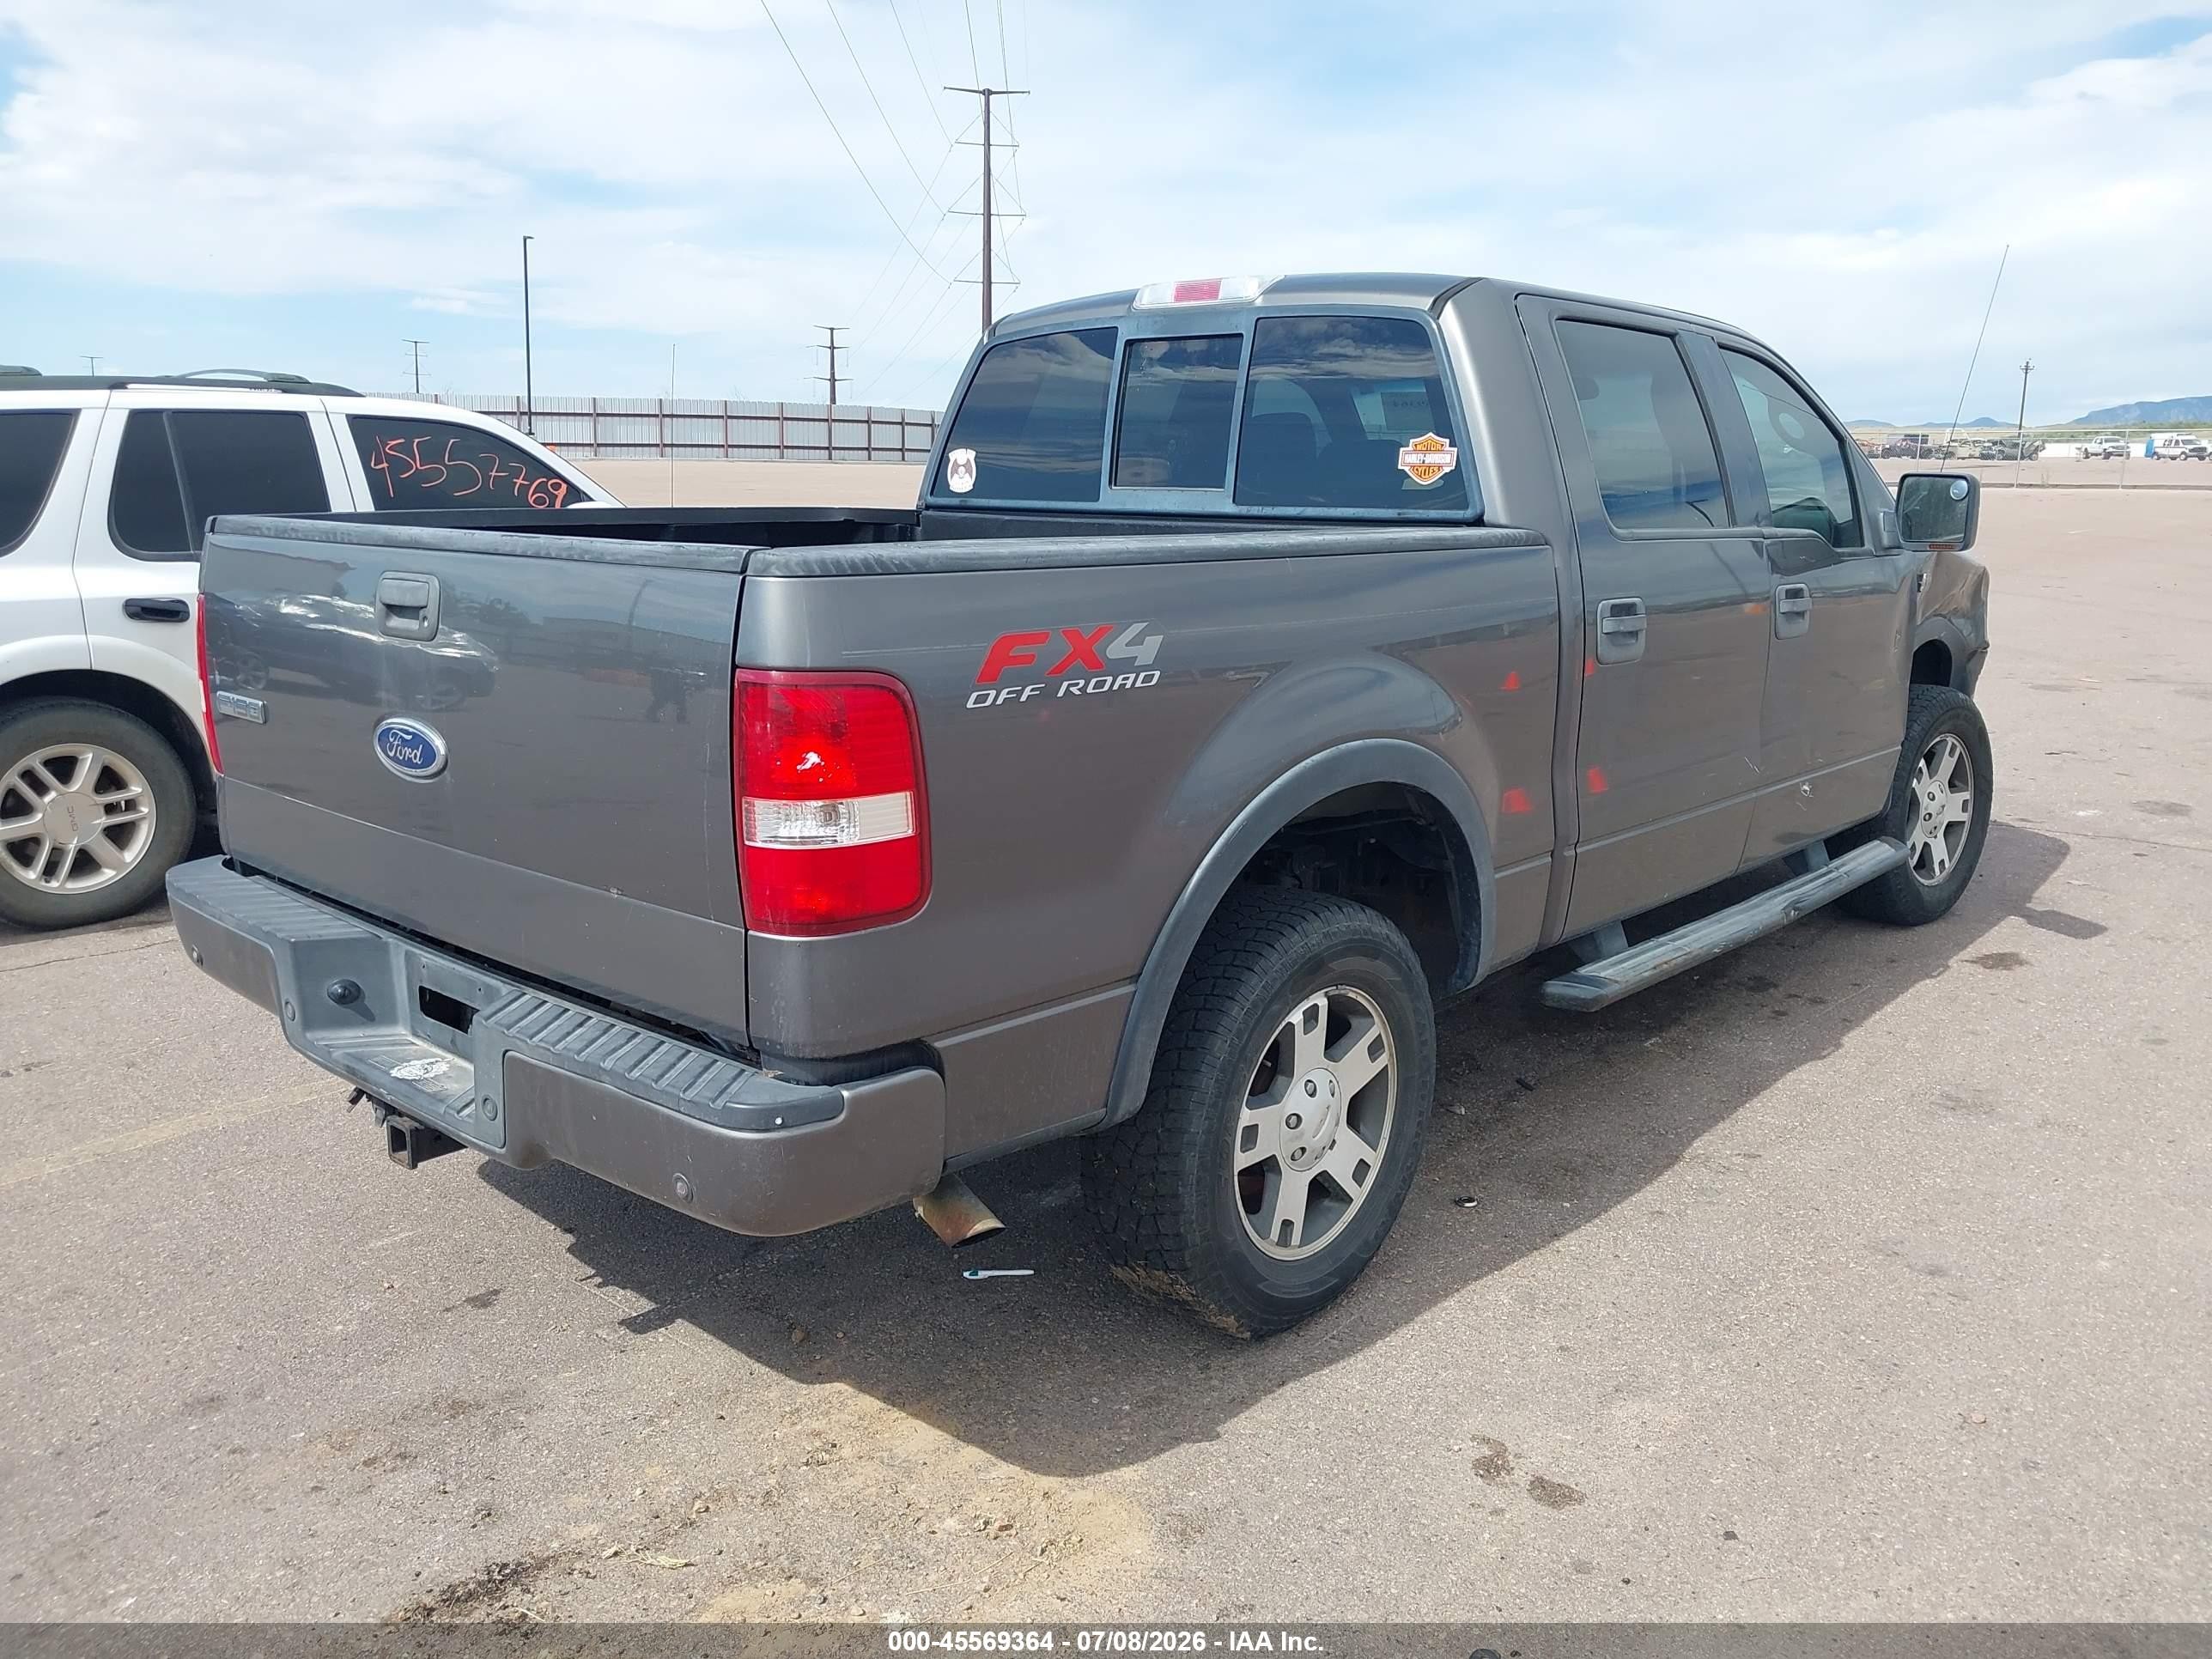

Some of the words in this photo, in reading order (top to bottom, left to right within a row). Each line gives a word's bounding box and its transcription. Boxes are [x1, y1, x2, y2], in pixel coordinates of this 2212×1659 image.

[1416, 439, 1442, 451] MOTOR
[371, 435, 568, 508] 45557769
[1413, 466, 1439, 478] CYCLES
[975, 622, 1164, 684] FX4
[966, 684, 1046, 708] OFF
[1056, 670, 1161, 697] ROAD
[386, 729, 423, 764] Ford
